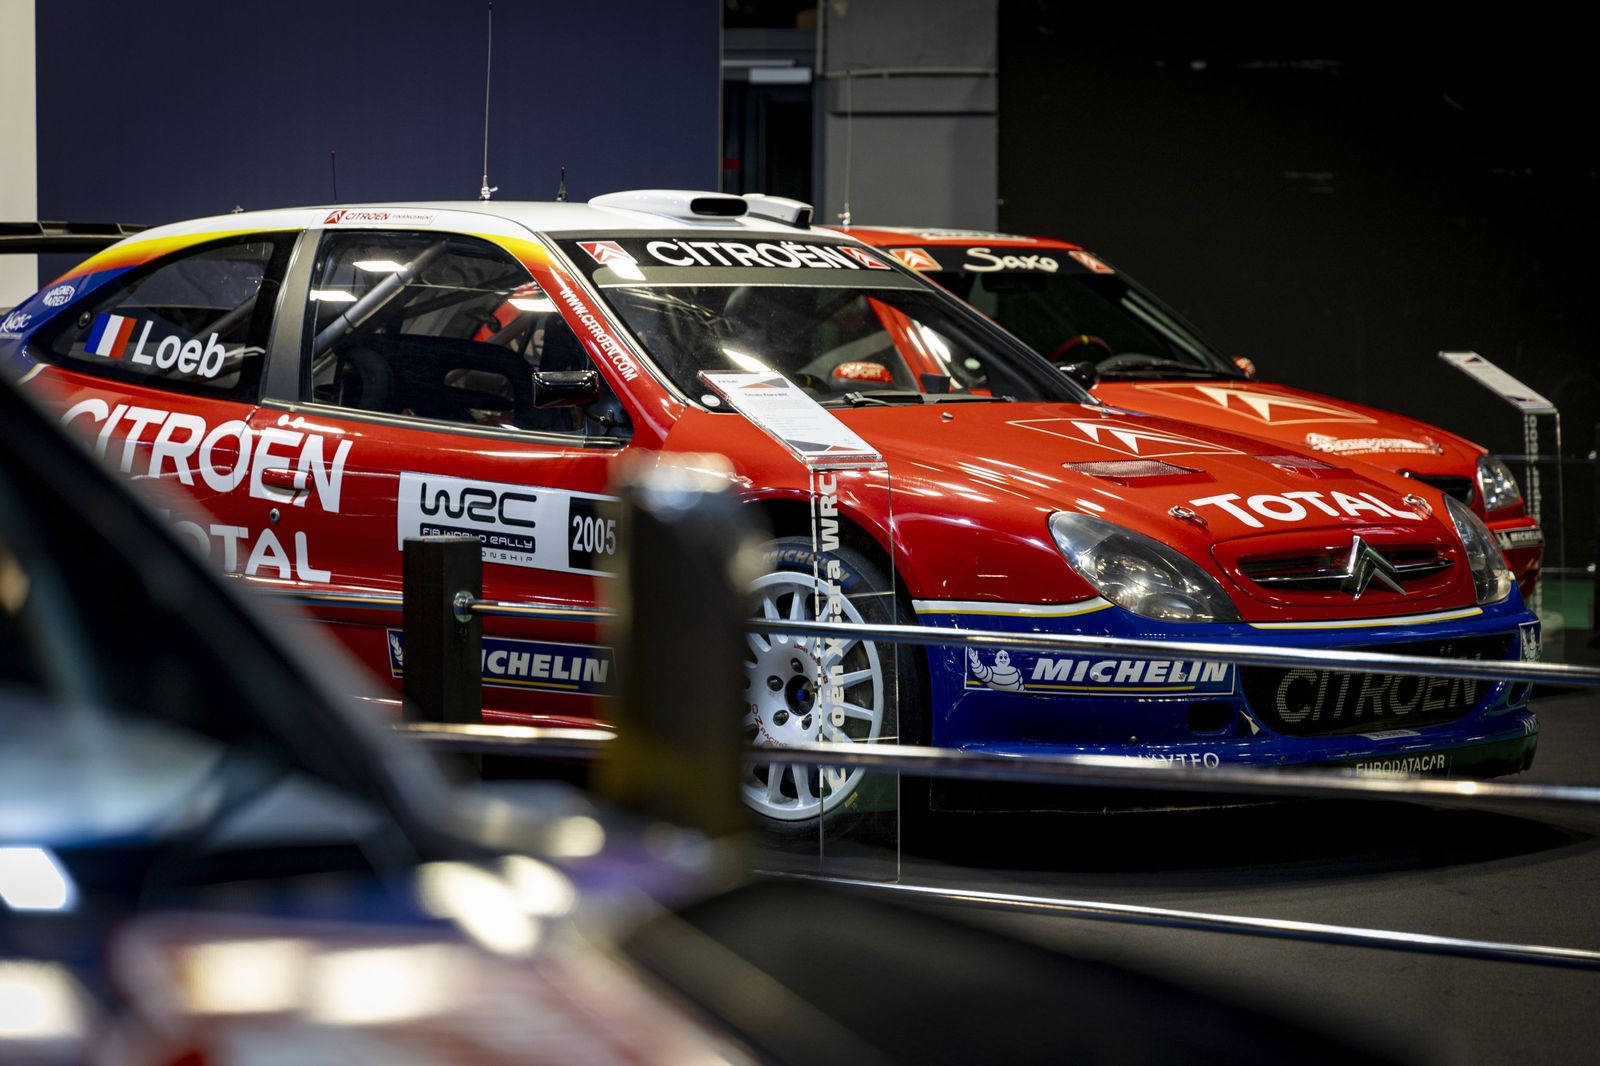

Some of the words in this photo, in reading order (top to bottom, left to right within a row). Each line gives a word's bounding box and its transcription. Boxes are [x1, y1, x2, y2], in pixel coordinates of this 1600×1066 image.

[646, 239, 860, 270] CITROËN
[963, 247, 1059, 272] Saxo
[132, 320, 226, 379] Loeb
[420, 482, 537, 528] WRC
[819, 473, 841, 552] WRC
[1191, 490, 1428, 528] TOTAL
[158, 508, 331, 583] OTAL
[490, 536, 533, 549] RALLY
[572, 515, 617, 555] 2005
[482, 551, 533, 562] ONSHIP
[763, 550, 850, 582] MICHELN
[482, 649, 609, 682] CHELIN
[1031, 658, 1228, 682] MICHELIN
[825, 664, 846, 789] Croën
